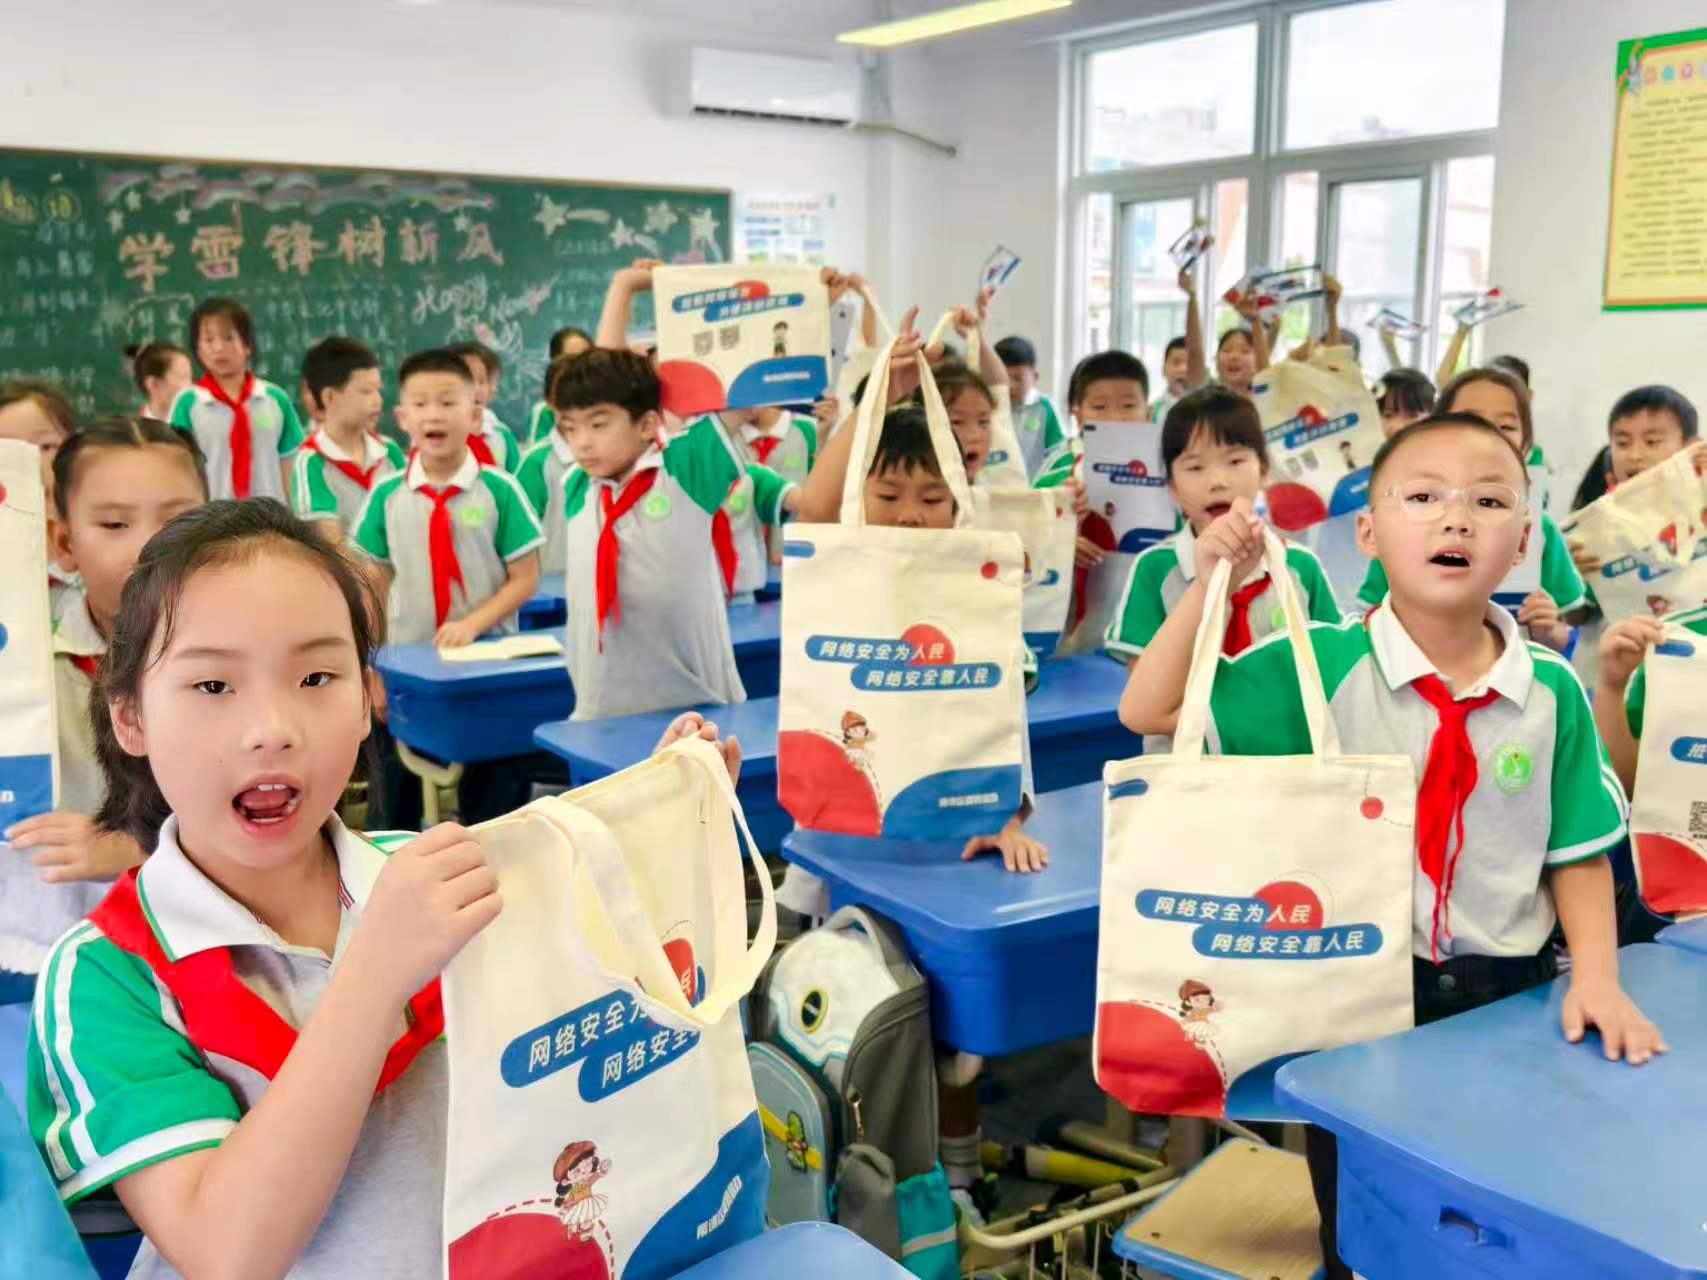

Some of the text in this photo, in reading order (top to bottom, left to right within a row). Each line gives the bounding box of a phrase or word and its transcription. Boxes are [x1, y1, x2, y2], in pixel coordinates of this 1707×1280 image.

[819, 640, 945, 661] 网络安全为人民
[866, 667, 989, 688] 网络安全靠人民
[1154, 897, 1312, 924] 网络安全为人民
[1210, 930, 1364, 954] 网络安全靠人民
[601, 1030, 698, 1089] 网络安全
